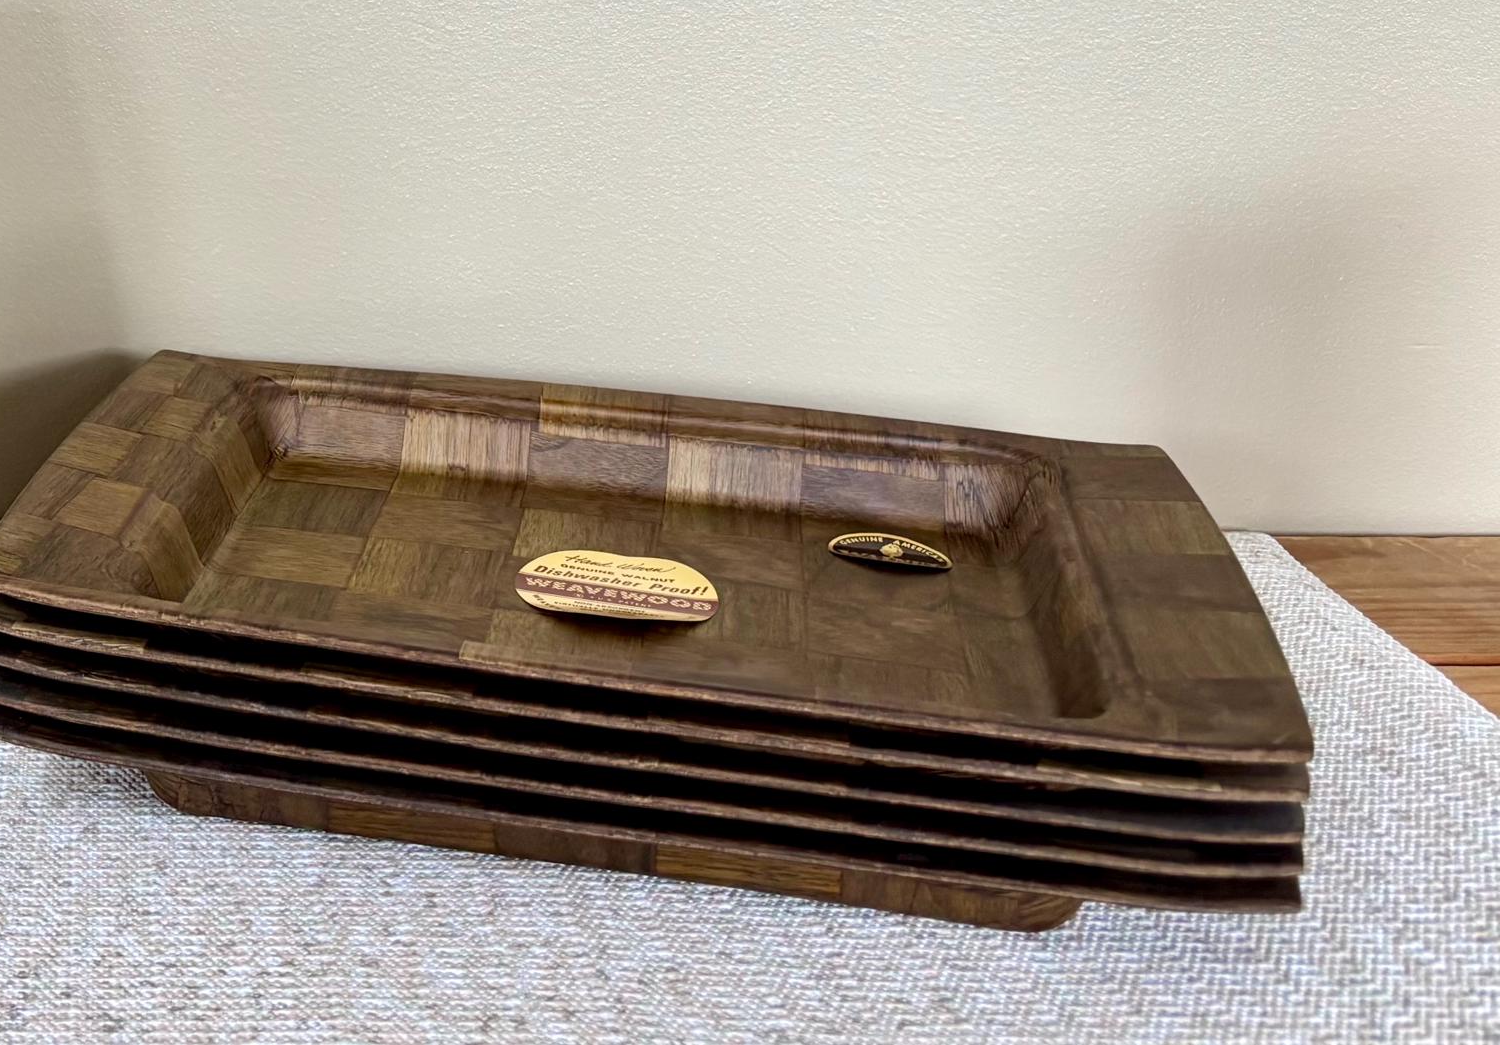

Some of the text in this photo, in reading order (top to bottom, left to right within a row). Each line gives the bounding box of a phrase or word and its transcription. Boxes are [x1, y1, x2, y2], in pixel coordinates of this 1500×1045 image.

[839, 536, 884, 546] GENUINE
[533, 565, 709, 596] Dishwasher Proof!
[560, 563, 675, 584] GENUINE WALNUT
[525, 577, 712, 611] WEAVEWOOD
